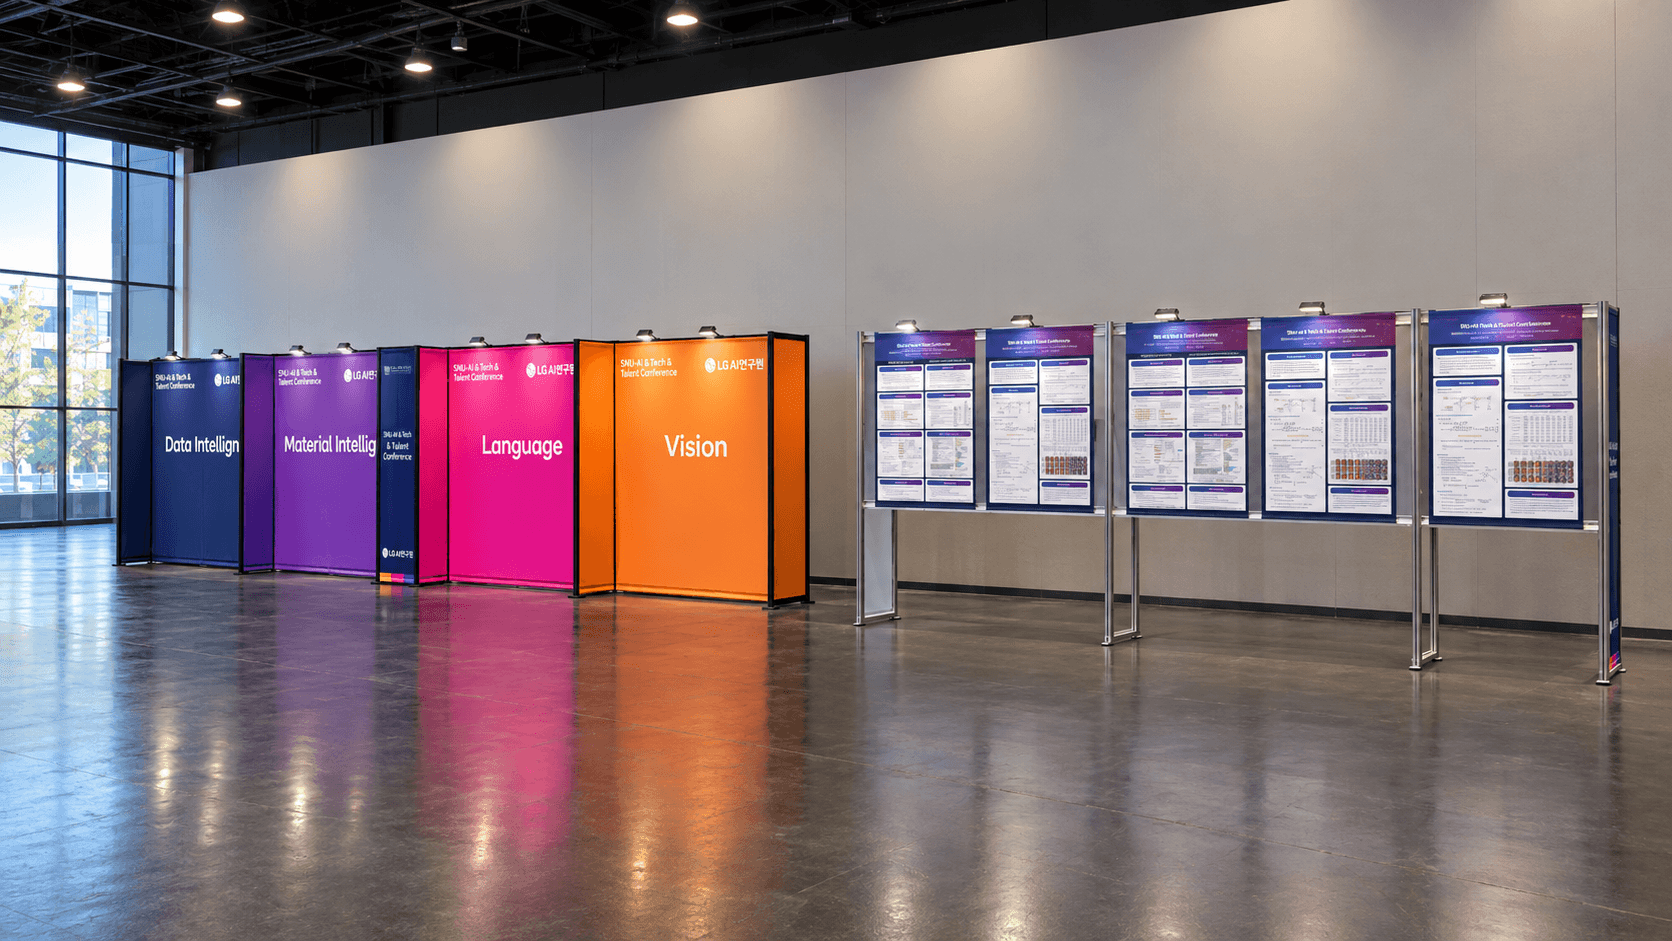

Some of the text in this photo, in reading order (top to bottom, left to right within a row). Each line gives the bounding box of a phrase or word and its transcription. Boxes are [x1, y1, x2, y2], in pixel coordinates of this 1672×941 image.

[620, 358, 643, 368] SNU-AI
[650, 357, 666, 367] Tech
[717, 360, 729, 370] LG
[353, 370, 362, 380] LG
[537, 365, 547, 375] LG
[222, 375, 230, 385] LG
[165, 436, 192, 453] Data
[284, 434, 377, 458] Material Intellig
[482, 435, 563, 460] Language
[664, 434, 728, 458] Vision
